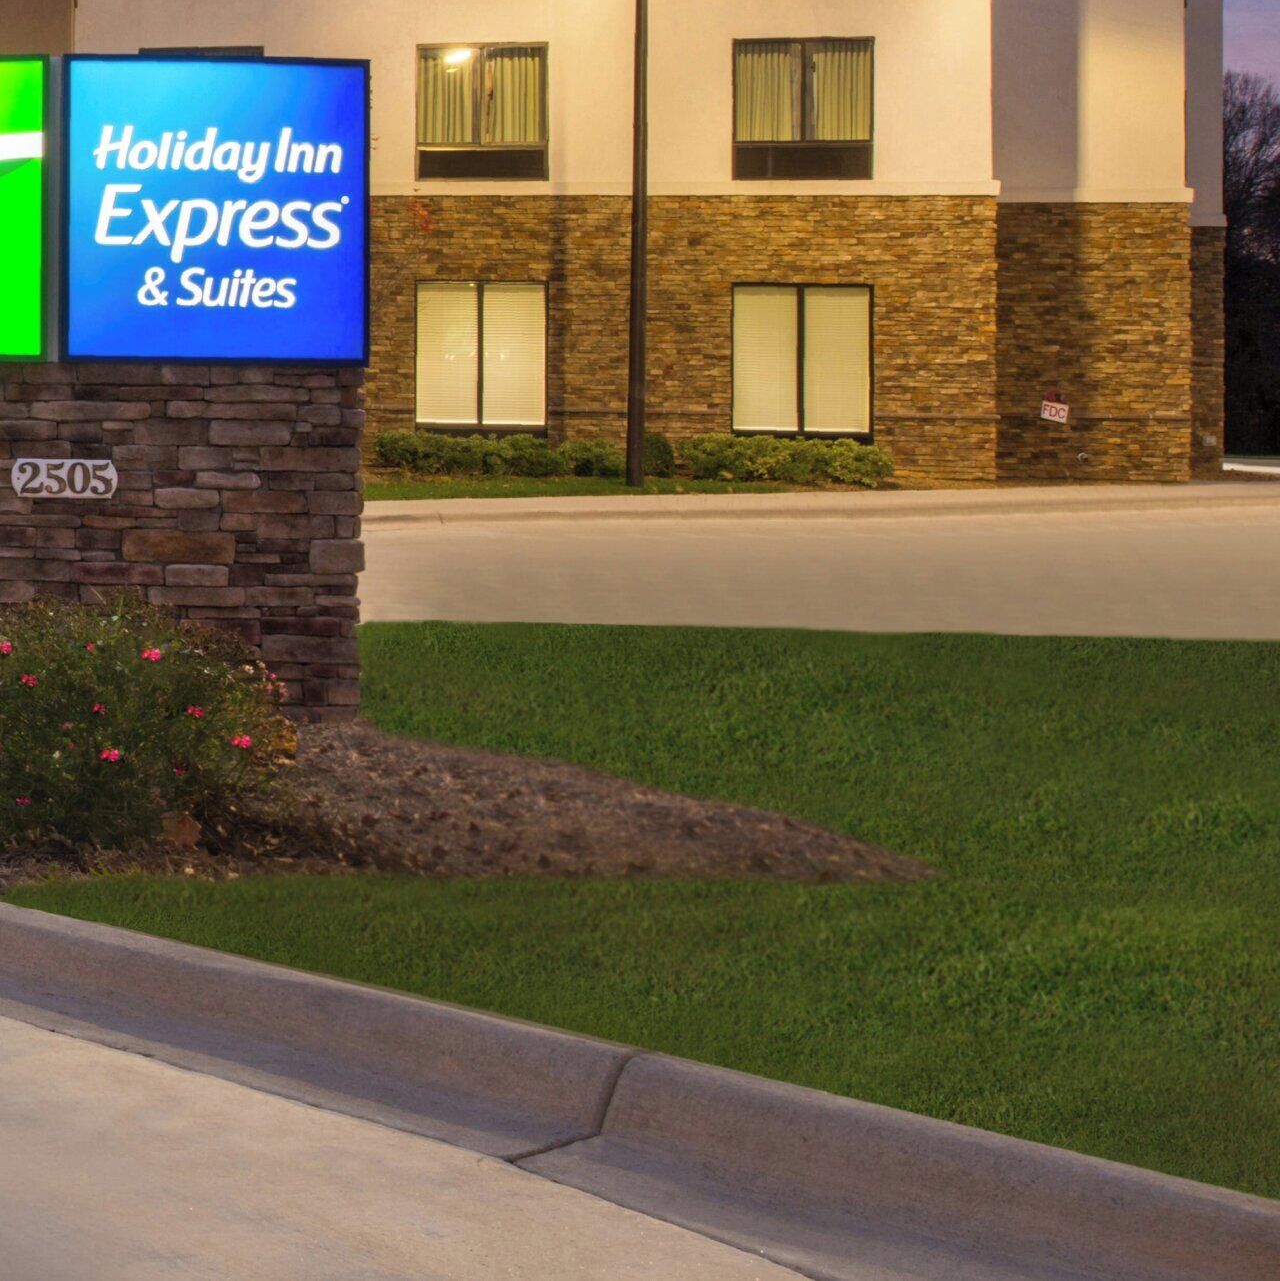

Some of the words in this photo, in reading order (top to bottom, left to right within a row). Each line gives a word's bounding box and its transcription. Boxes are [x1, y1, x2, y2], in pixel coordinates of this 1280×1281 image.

[93, 124, 271, 184] Holiday
[274, 126, 343, 174] Inn
[93, 183, 343, 263] Express
[137, 266, 169, 307] &
[175, 266, 298, 309] Suites
[1043, 404, 1065, 419] FDC
[18, 461, 113, 495] 2505
